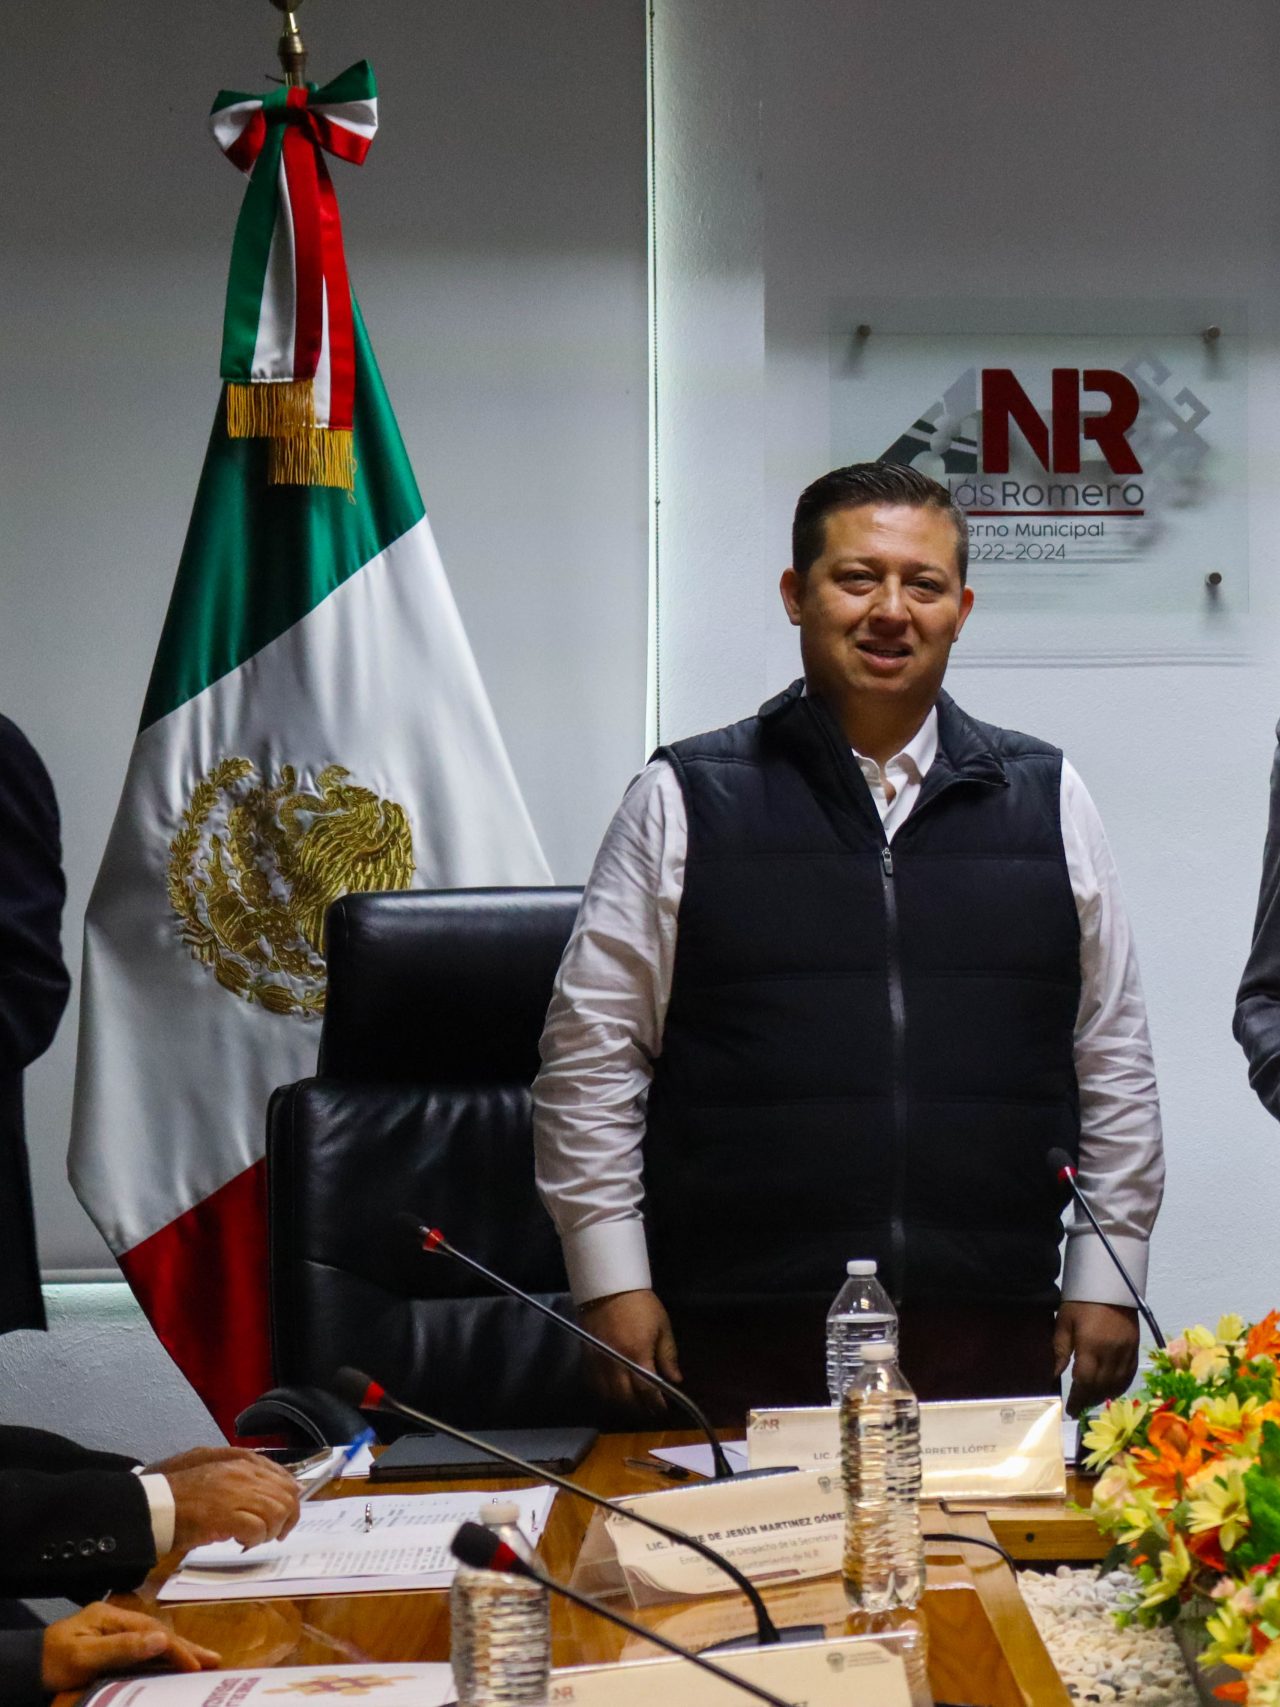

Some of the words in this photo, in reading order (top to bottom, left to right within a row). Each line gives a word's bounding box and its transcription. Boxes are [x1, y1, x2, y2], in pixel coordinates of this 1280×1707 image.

[982, 368, 1144, 475] NR
[1002, 481, 1144, 507] Romero
[968, 522, 1009, 537] erno
[1015, 521, 1105, 540] Municipal
[969, 544, 1066, 560] 022-2024
[919, 1445, 960, 1455] ARRETE
[962, 1443, 997, 1455] LÓPEZ
[708, 1532, 721, 1541] DE
[725, 1525, 758, 1538] JESÚS
